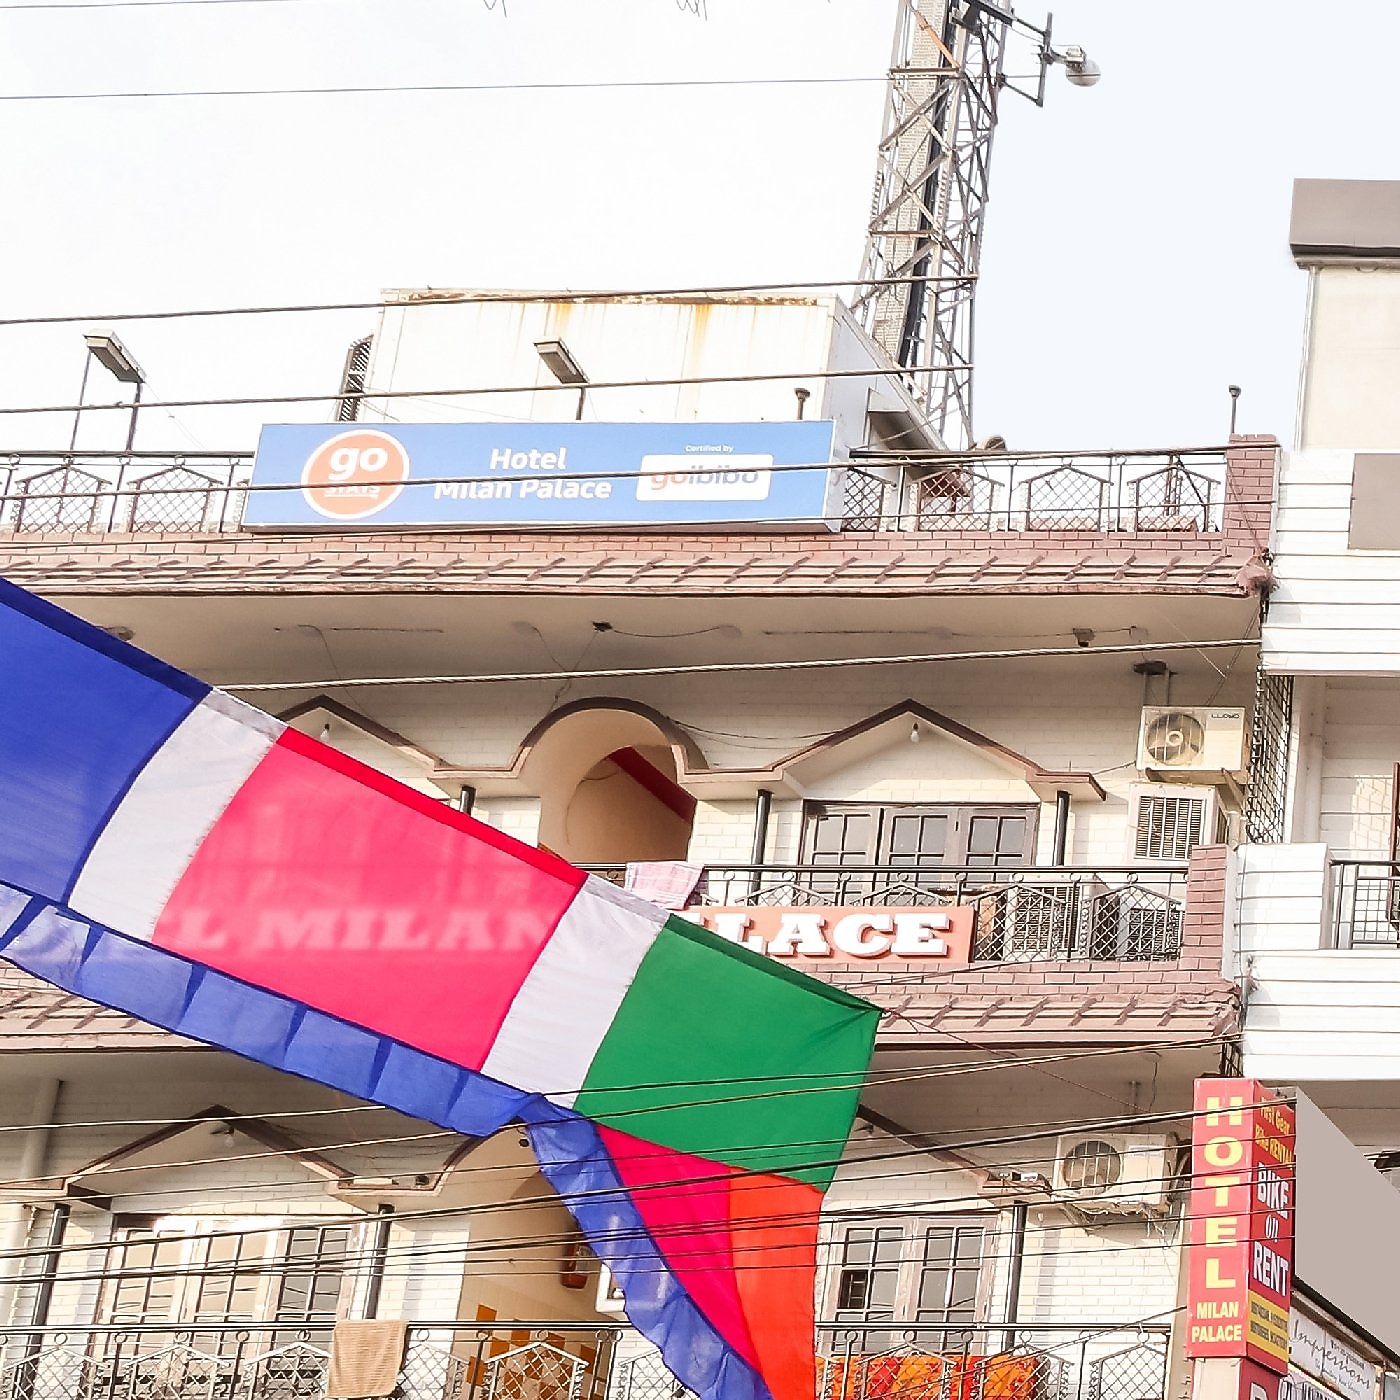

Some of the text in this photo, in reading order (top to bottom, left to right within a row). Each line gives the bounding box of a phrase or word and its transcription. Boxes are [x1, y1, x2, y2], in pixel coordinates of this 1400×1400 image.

[330, 448, 387, 477] go
[489, 448, 566, 471] Hotel
[433, 477, 612, 500] Milan Palace
[1204, 1096, 1243, 1289] HOTEL
[1256, 1162, 1289, 1220] BIKE
[1252, 1241, 1289, 1297] RENT
[1196, 1301, 1239, 1320] MILAN
[1191, 1325, 1242, 1343] PALACE
